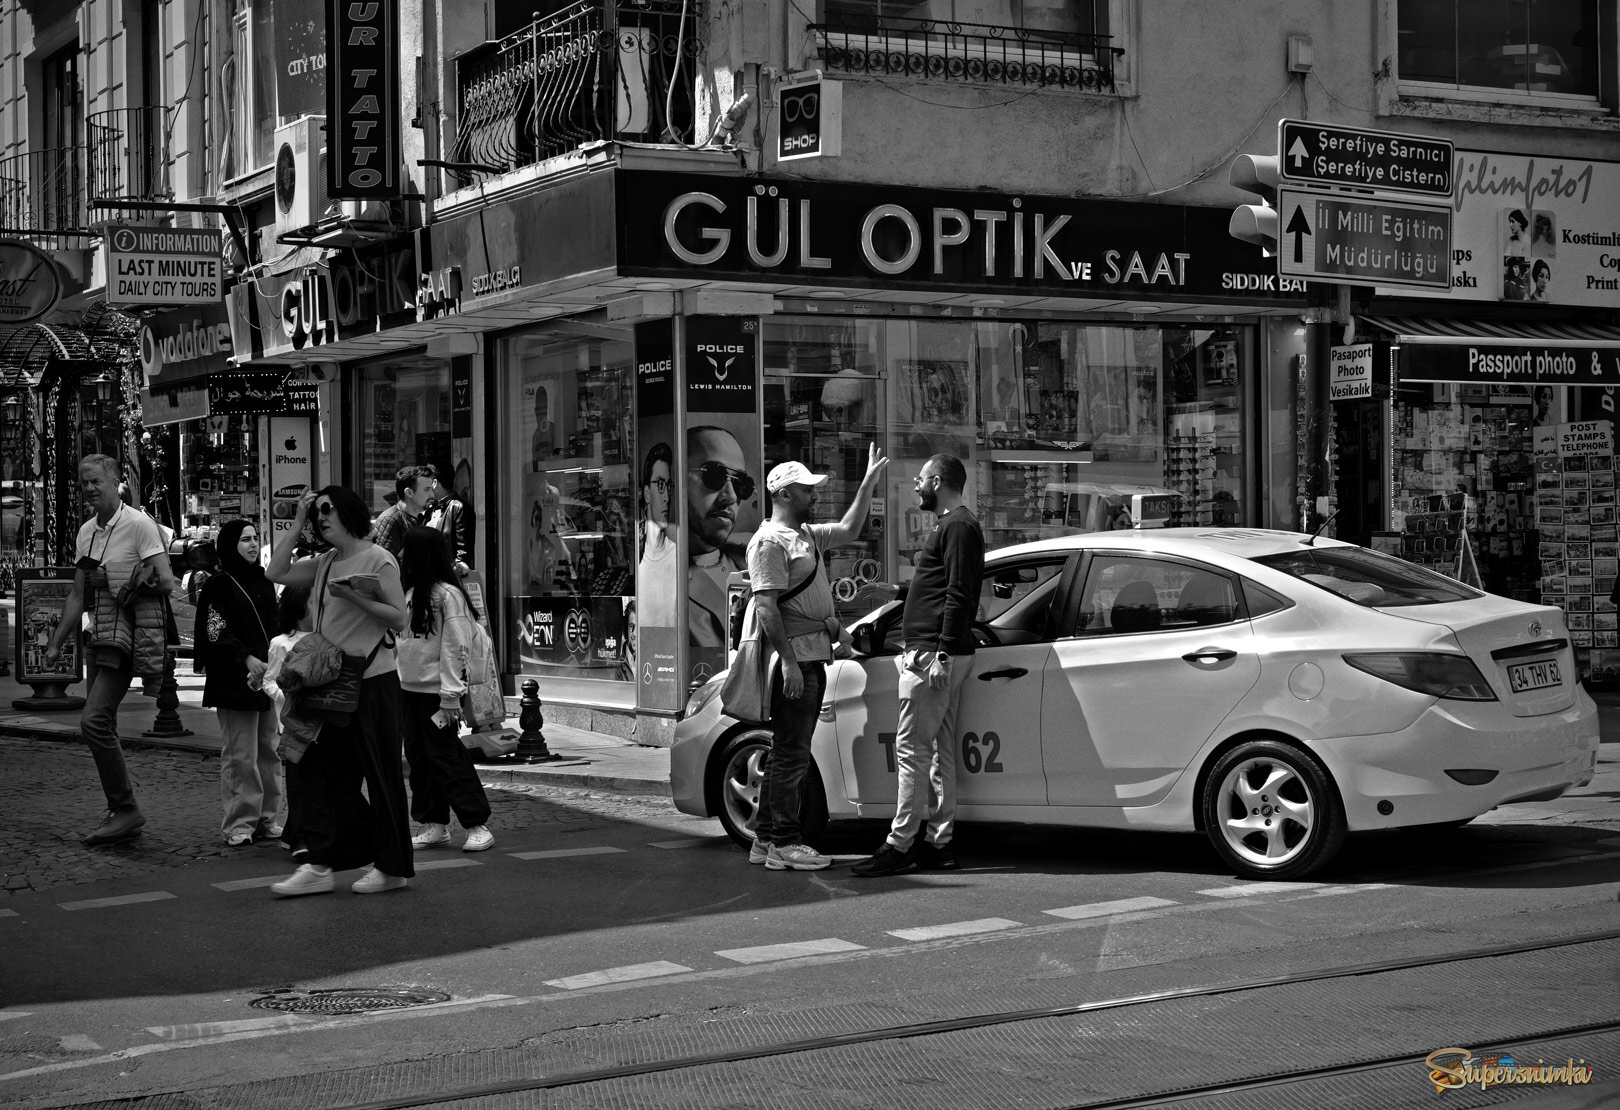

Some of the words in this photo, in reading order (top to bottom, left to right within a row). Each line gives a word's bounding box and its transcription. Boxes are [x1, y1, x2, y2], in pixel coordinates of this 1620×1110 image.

[287, 58, 308, 77] CITY
[348, 69, 382, 188] TATTO
[783, 133, 818, 151] SHOP
[1318, 131, 1385, 158] Şerefiye
[1389, 140, 1445, 163] Sarnıcı
[1313, 155, 1385, 182] (Şerefiye
[1389, 164, 1450, 191] Cistern)
[1337, 210, 1374, 234] Milli
[1381, 214, 1444, 242] Eğitim
[139, 232, 219, 253] INFORMATION
[664, 184, 832, 268] GÜL
[861, 197, 1074, 281] OPTİK
[1071, 261, 1092, 281] VE
[1103, 249, 1191, 286] SAAT
[1221, 272, 1275, 291] SIDDIK
[117, 258, 154, 276] LAST
[158, 259, 216, 278] MINUTE
[1326, 242, 1438, 278] Müdürlüğü
[118, 279, 150, 296] DAILY
[152, 280, 178, 297] CITY
[180, 281, 217, 298] TOURS
[1585, 274, 1619, 290] Print
[280, 265, 331, 339] GÜL
[158, 318, 232, 364] vodafone
[697, 344, 745, 353] POLICE
[1331, 346, 1372, 363] Pasaport
[1469, 347, 1532, 379] Passport
[1535, 350, 1576, 379] photo
[1590, 351, 1603, 376] &
[638, 359, 672, 375] POLICE
[1337, 364, 1366, 378] Photo
[1331, 382, 1371, 399] Vesikalık
[1563, 431, 1606, 442] STAMPS
[1570, 422, 1598, 432] POST
[1560, 441, 1610, 452] TELEPHONE
[275, 454, 307, 464] iPhone
[278, 488, 304, 496] SAMSUN
[275, 521, 294, 531] SO
[533, 610, 553, 623] Wizard
[1514, 667, 1529, 688] 34
[1528, 664, 1549, 686] THV
[1548, 662, 1561, 682] 62
[961, 731, 1004, 773] 62
